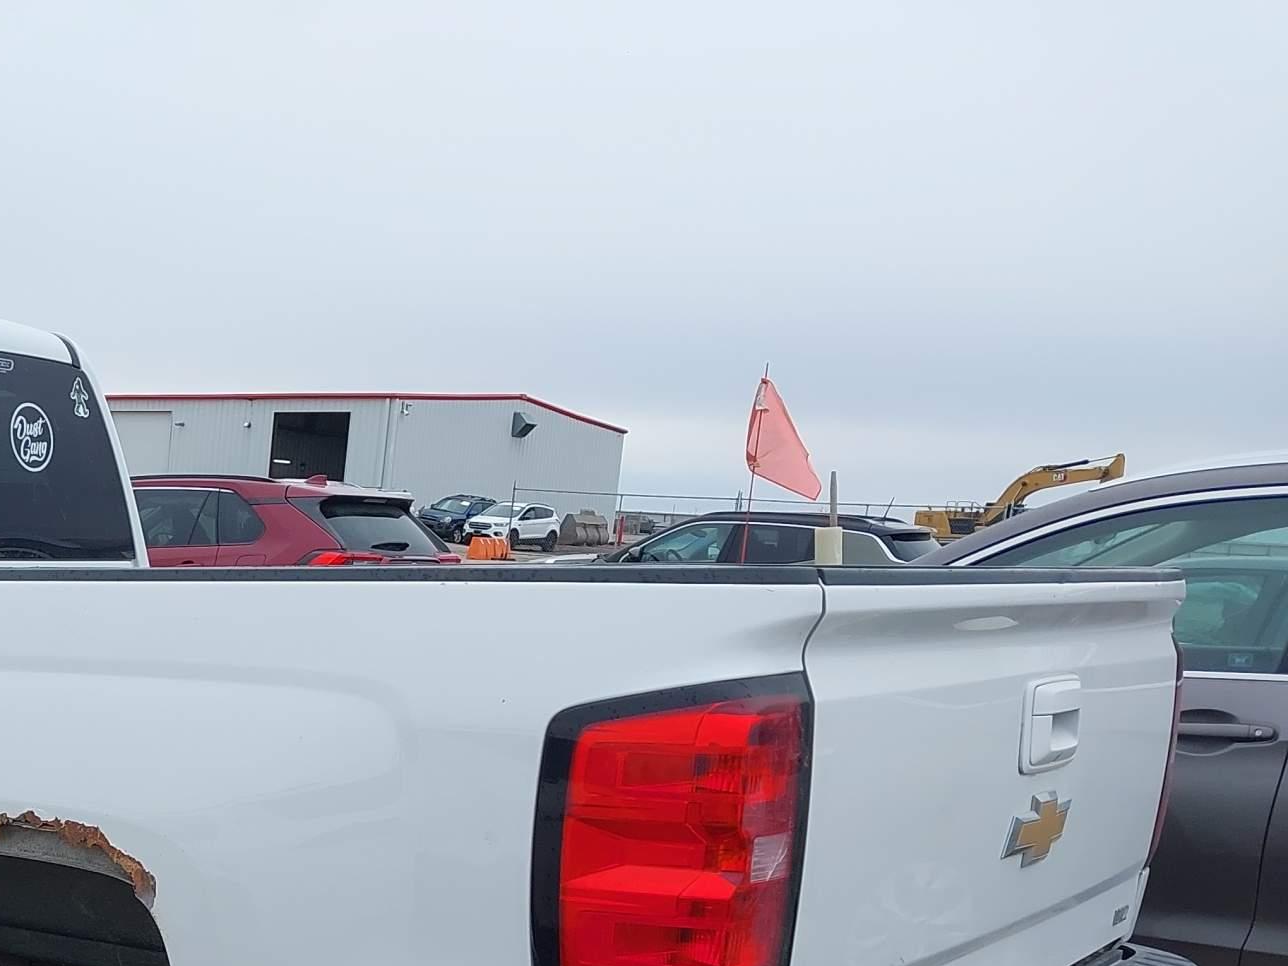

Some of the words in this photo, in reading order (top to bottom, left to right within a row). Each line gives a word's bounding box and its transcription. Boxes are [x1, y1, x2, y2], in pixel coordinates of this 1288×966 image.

[14, 415, 46, 440] Dust
[20, 438, 48, 463] Gang
[1052, 473, 1065, 481] CAT
